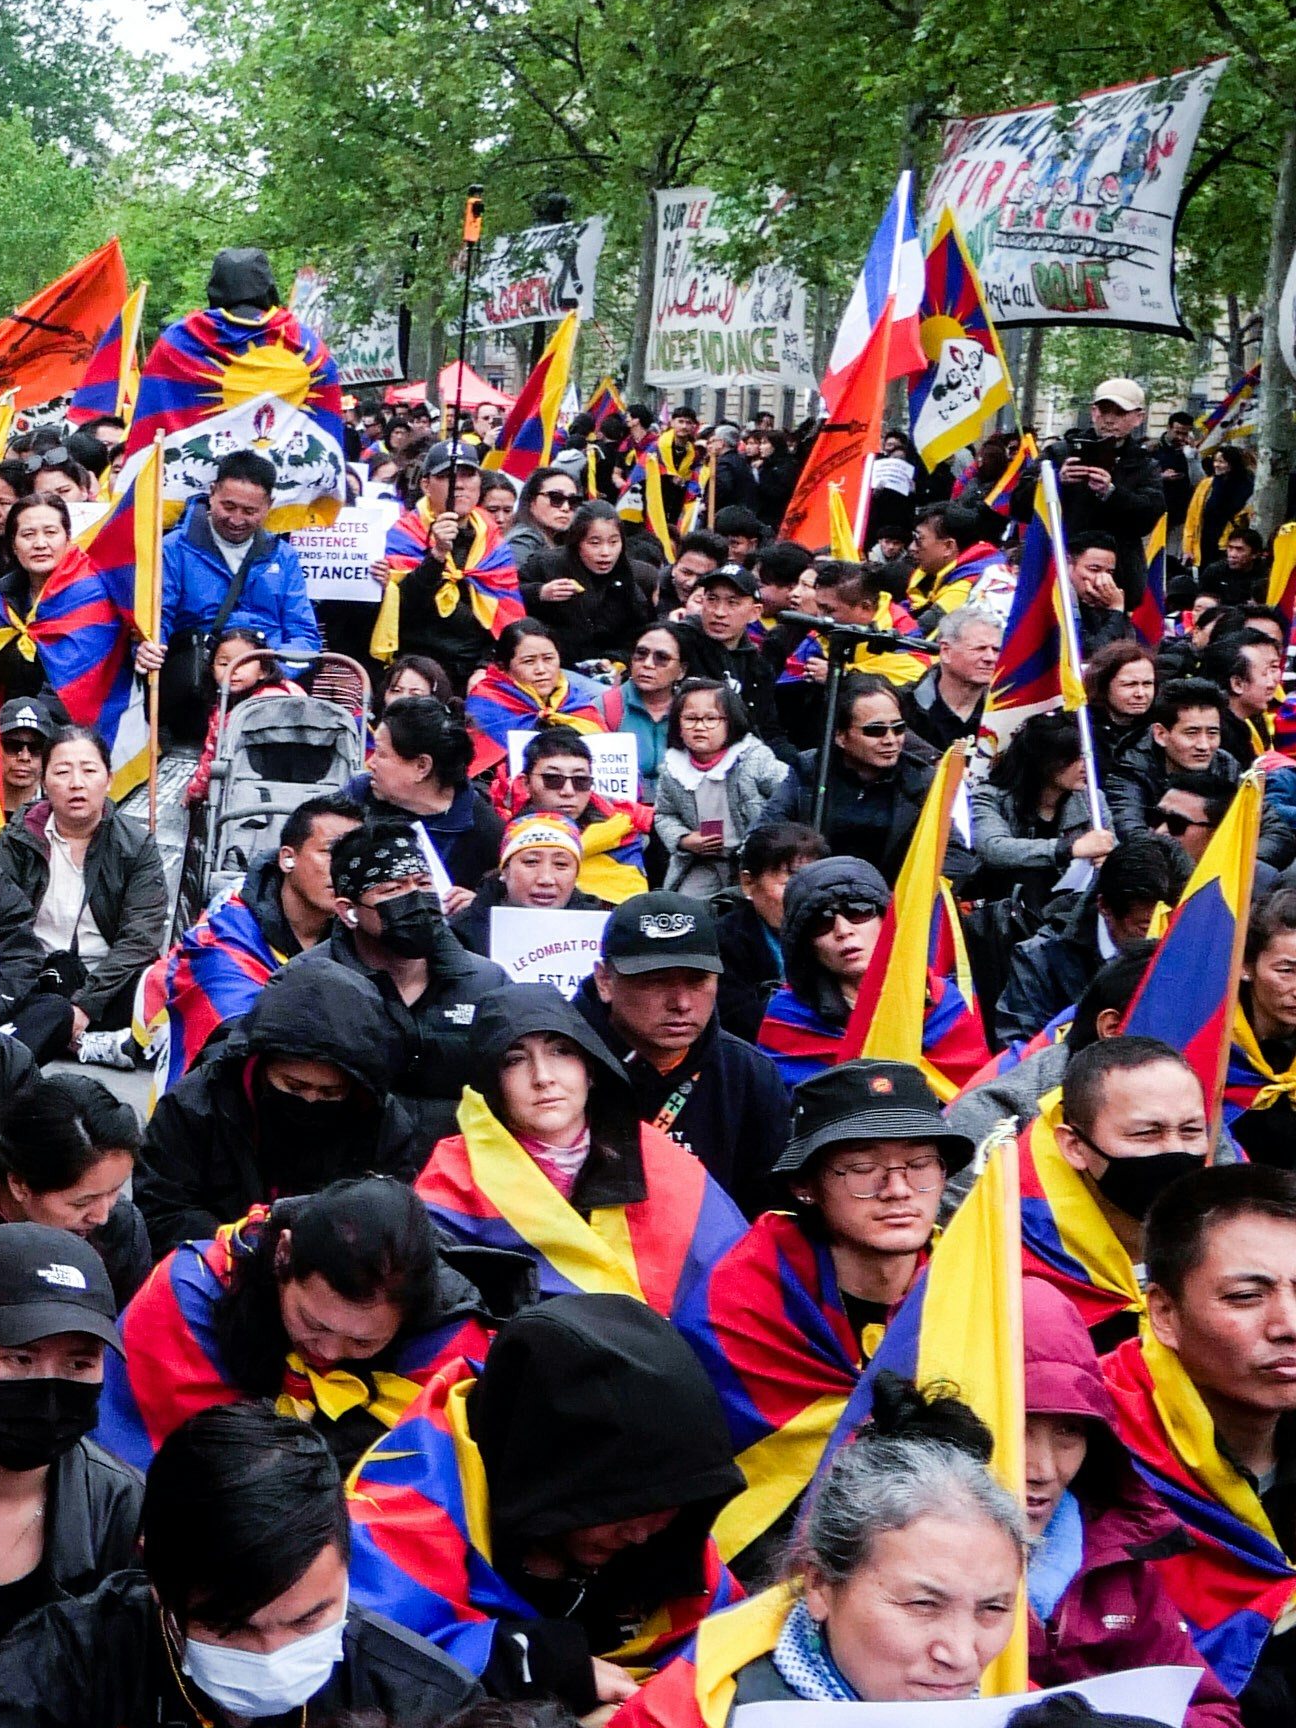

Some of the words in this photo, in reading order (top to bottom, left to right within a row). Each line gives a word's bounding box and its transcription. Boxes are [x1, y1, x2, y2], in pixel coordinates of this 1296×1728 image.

[600, 753, 628, 764] SONT
[640, 913, 696, 932] BOSS
[513, 957, 528, 972] LE
[528, 940, 578, 963] COMBAT
